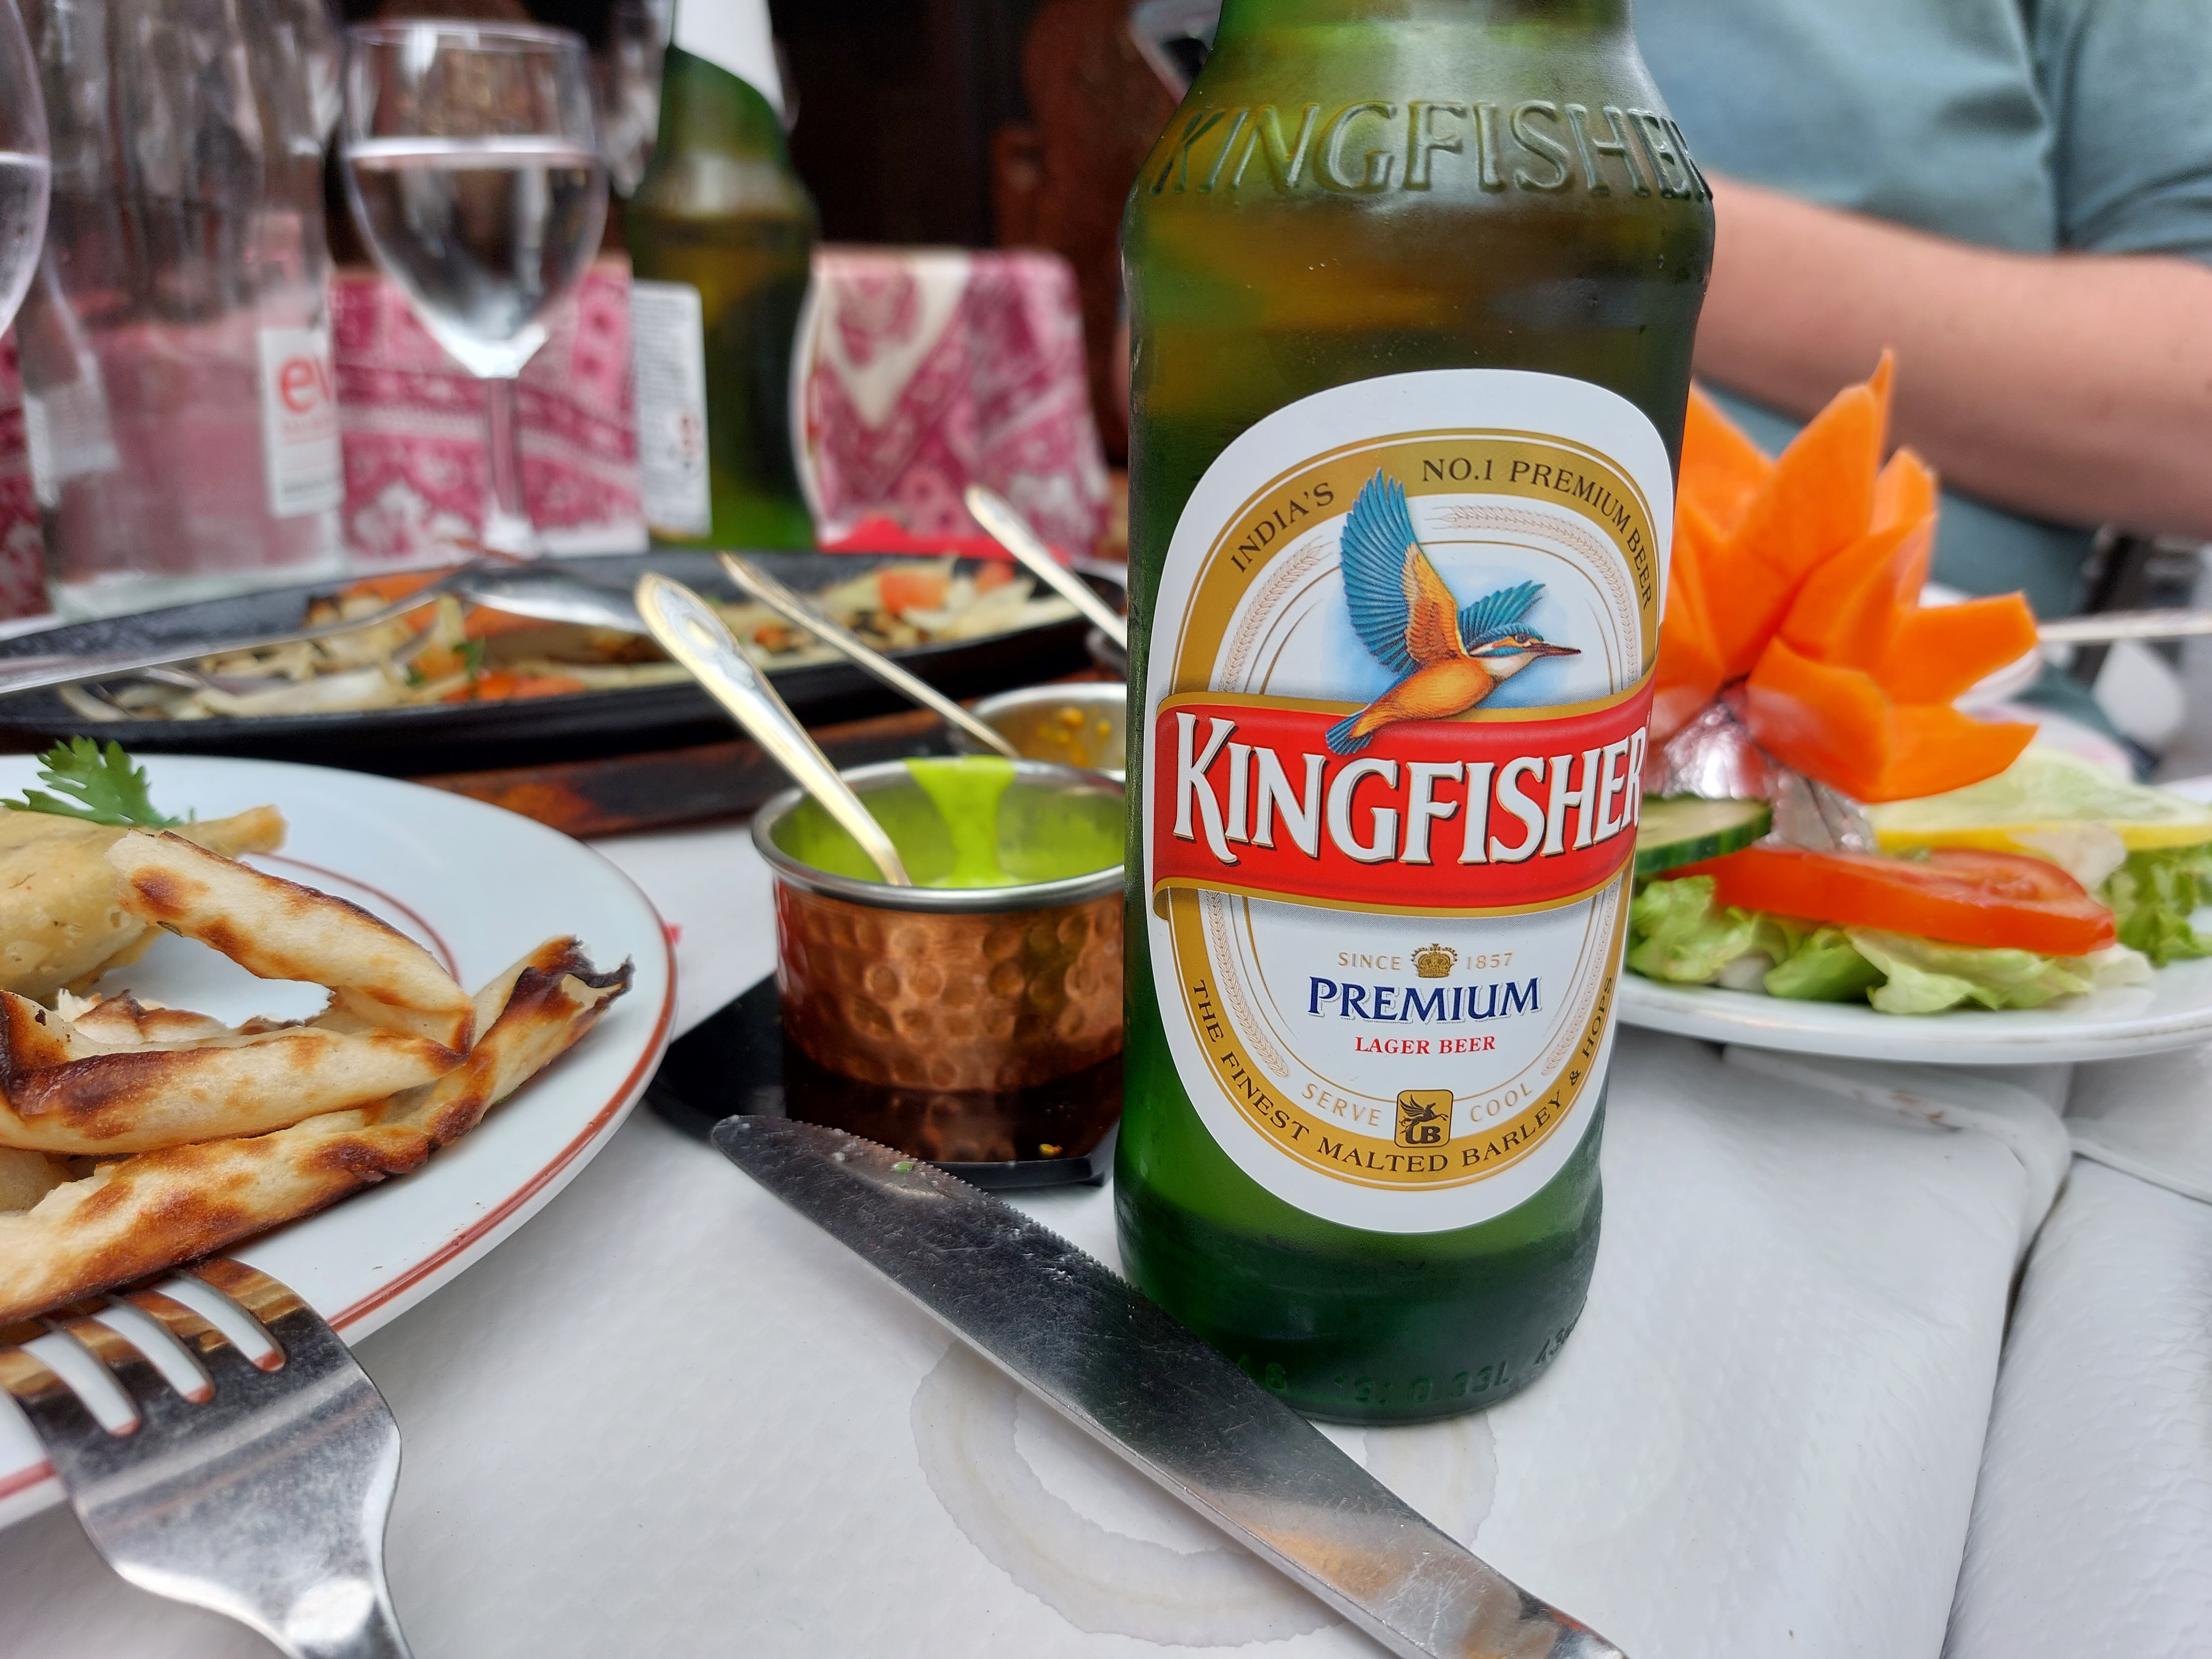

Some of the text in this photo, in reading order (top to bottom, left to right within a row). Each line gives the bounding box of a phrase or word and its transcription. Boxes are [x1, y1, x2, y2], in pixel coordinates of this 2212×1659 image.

[1229, 458, 1653, 611] INDIA'S NO.1 PREMIUM BEER
[1173, 711, 1647, 864] KINGFISHER
[1337, 951, 1515, 971] SINCE 1857
[1308, 975, 1542, 1025] PREMIUM
[1355, 1035, 1496, 1055] LAGER BEER
[1191, 975, 1615, 1173] THE FINEST MALTED BARLEY & HOPS
[1300, 1082, 1533, 1127] SERVE COOL
